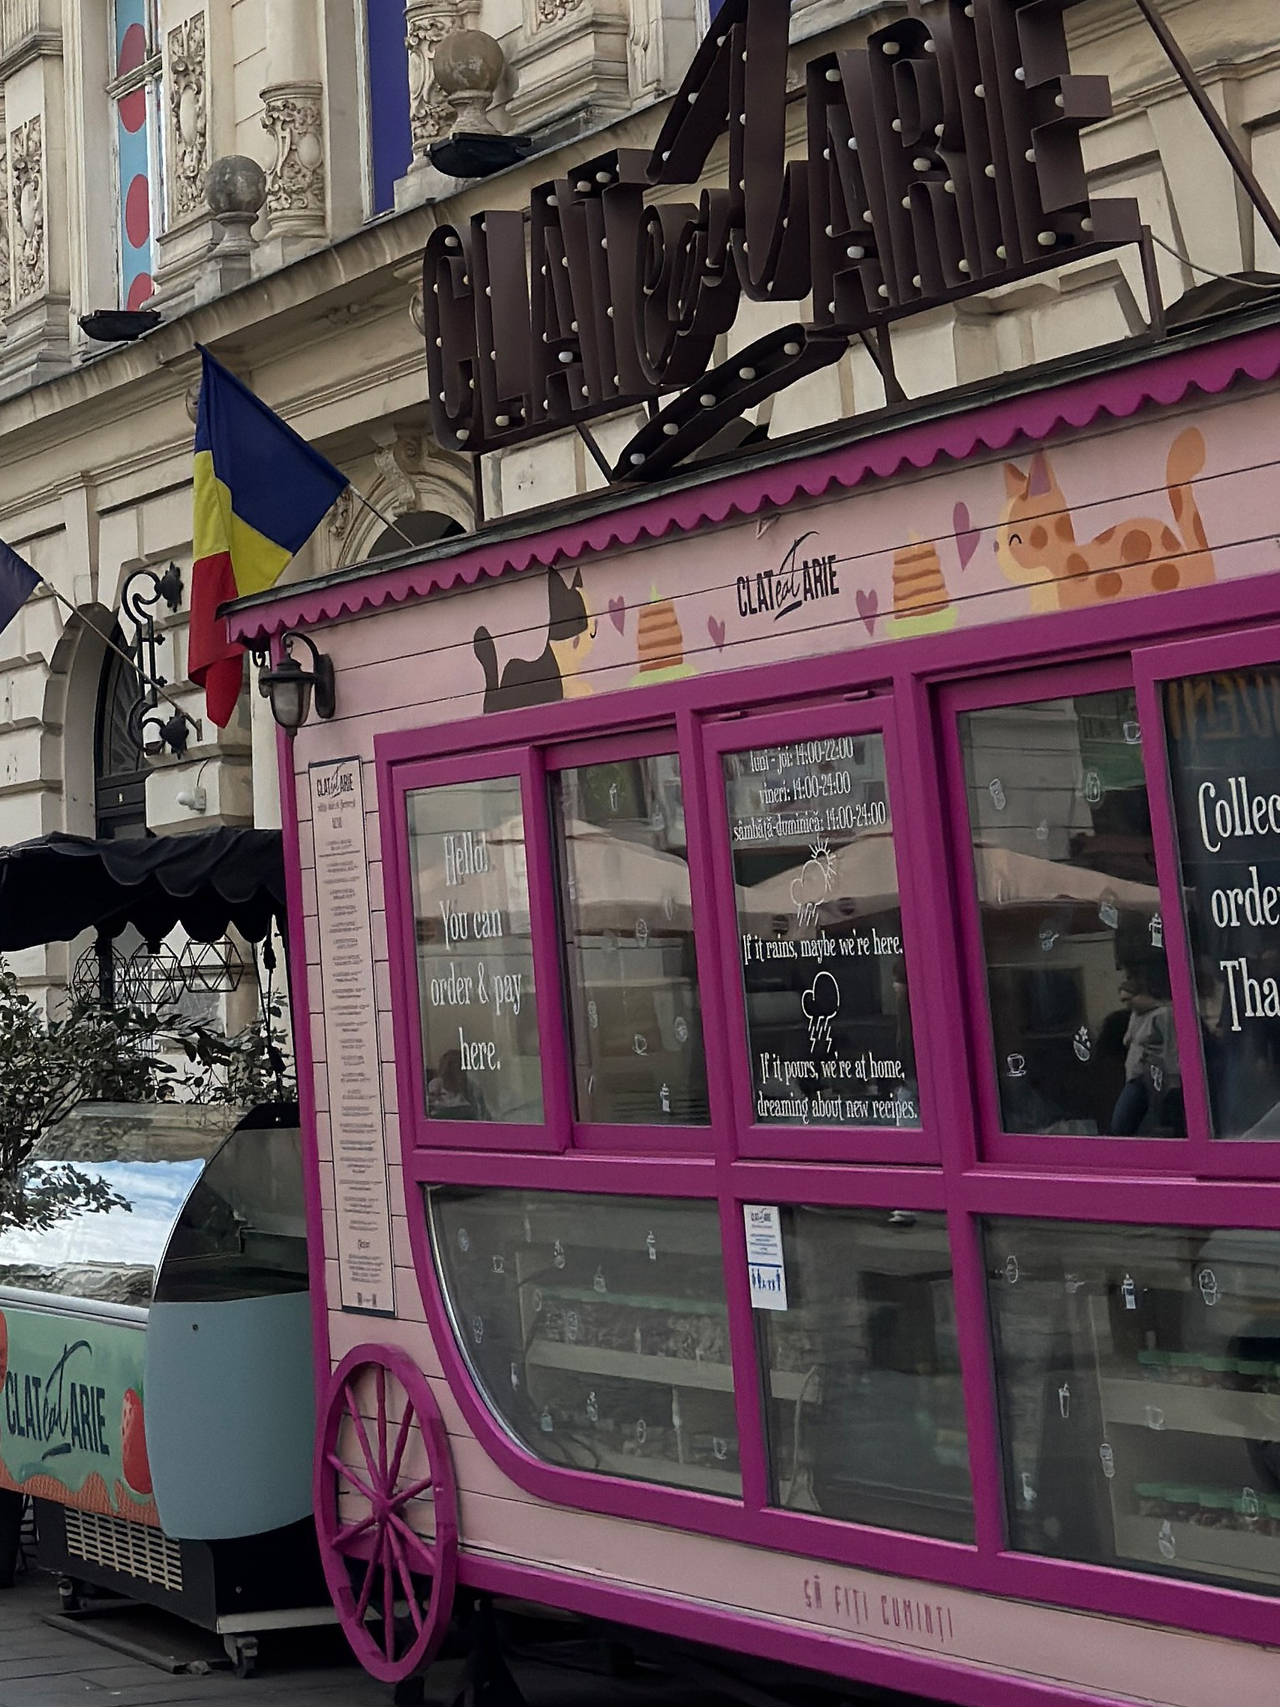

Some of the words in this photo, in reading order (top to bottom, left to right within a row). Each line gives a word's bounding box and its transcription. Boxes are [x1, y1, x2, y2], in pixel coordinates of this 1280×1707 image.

[750, 749, 769, 772] luni
[777, 746, 794, 775] joi:
[759, 781, 791, 805] vineri:
[443, 831, 489, 886] Hello!
[1212, 866, 1280, 929] orde
[439, 899, 468, 951] You
[474, 908, 503, 937] can
[743, 934, 752, 965] If
[755, 936, 764, 962] it
[766, 934, 798, 959] rains,
[801, 930, 837, 964] maybe
[872, 928, 903, 954] here.
[431, 962, 472, 1006] order
[478, 962, 490, 1004] &
[494, 972, 522, 1016] pay
[458, 1027, 501, 1071] here.
[760, 1053, 770, 1084] If
[772, 1053, 782, 1082] it
[785, 1059, 819, 1085] pours,
[855, 1056, 868, 1082] at
[869, 1051, 905, 1080] home,
[757, 1091, 809, 1124] dreaming
[812, 1091, 845, 1121] about
[846, 1099, 869, 1118] new
[873, 1093, 918, 1126] recipes.
